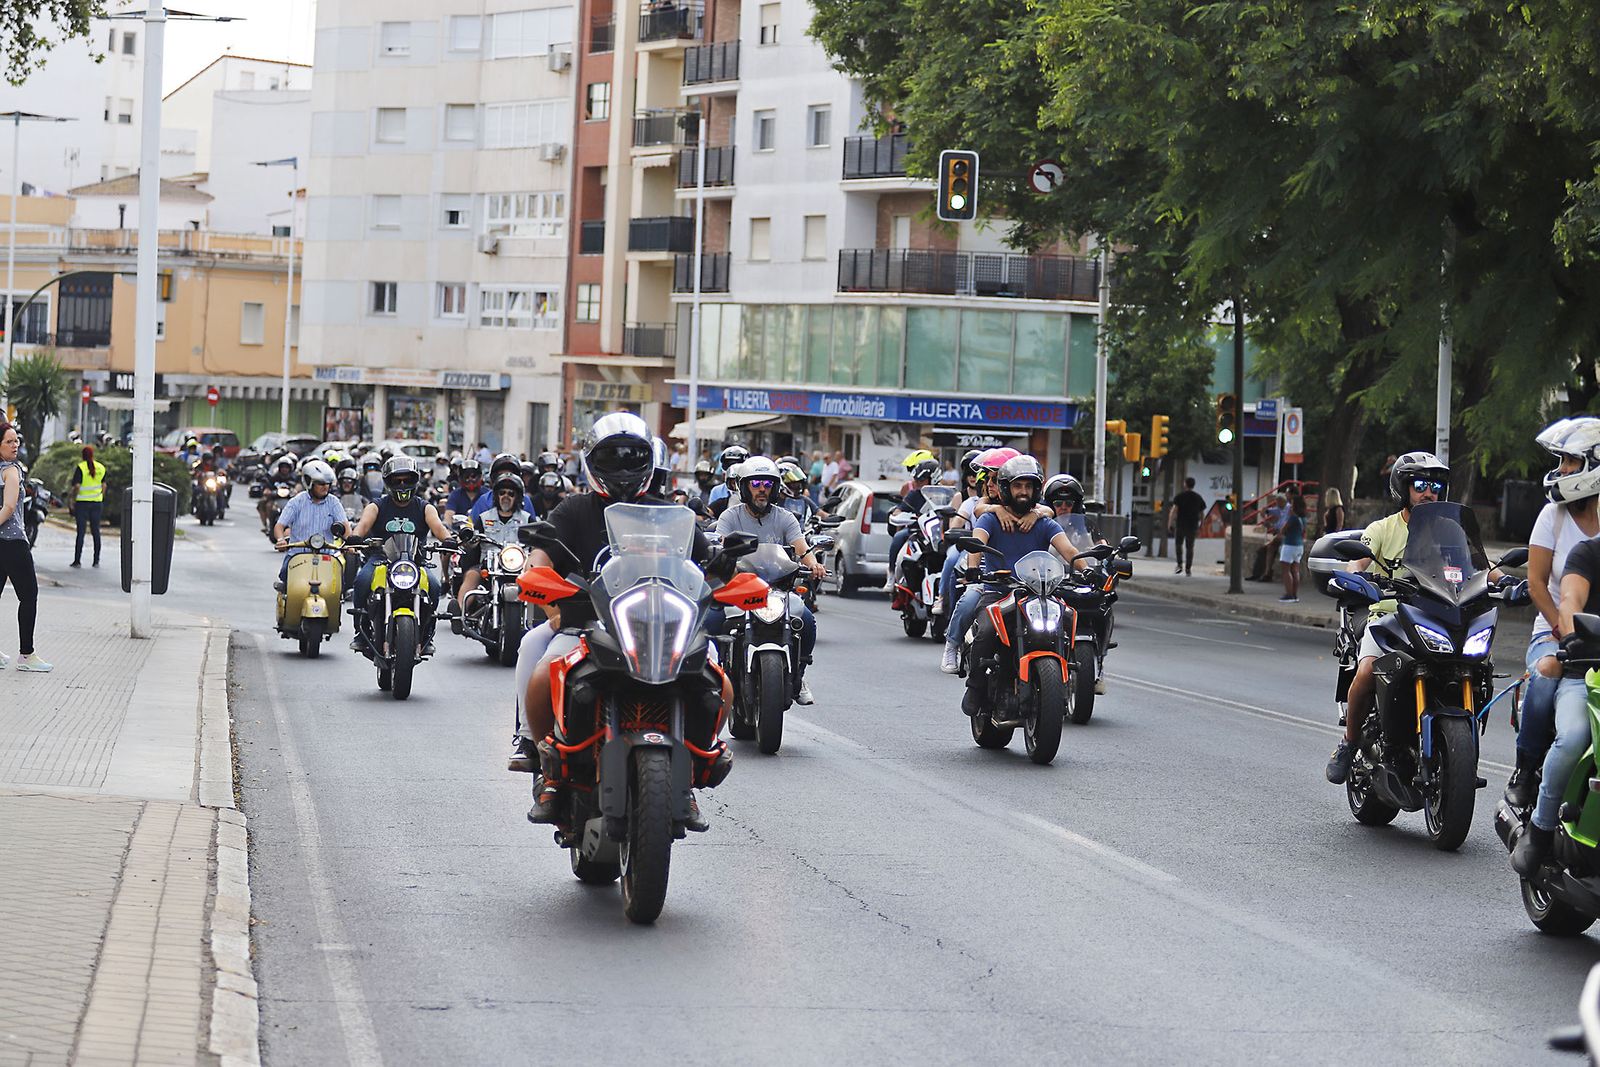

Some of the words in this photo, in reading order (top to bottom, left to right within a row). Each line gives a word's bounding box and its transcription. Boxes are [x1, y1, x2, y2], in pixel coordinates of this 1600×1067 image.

[116, 374, 134, 390] MI
[733, 389, 770, 409] HUERTA
[820, 394, 886, 417] Inmobiliaria
[909, 401, 983, 420] HUERTA
[985, 405, 1064, 423] GRANDE
[525, 590, 547, 600] KTM
[743, 596, 764, 605] KTM
